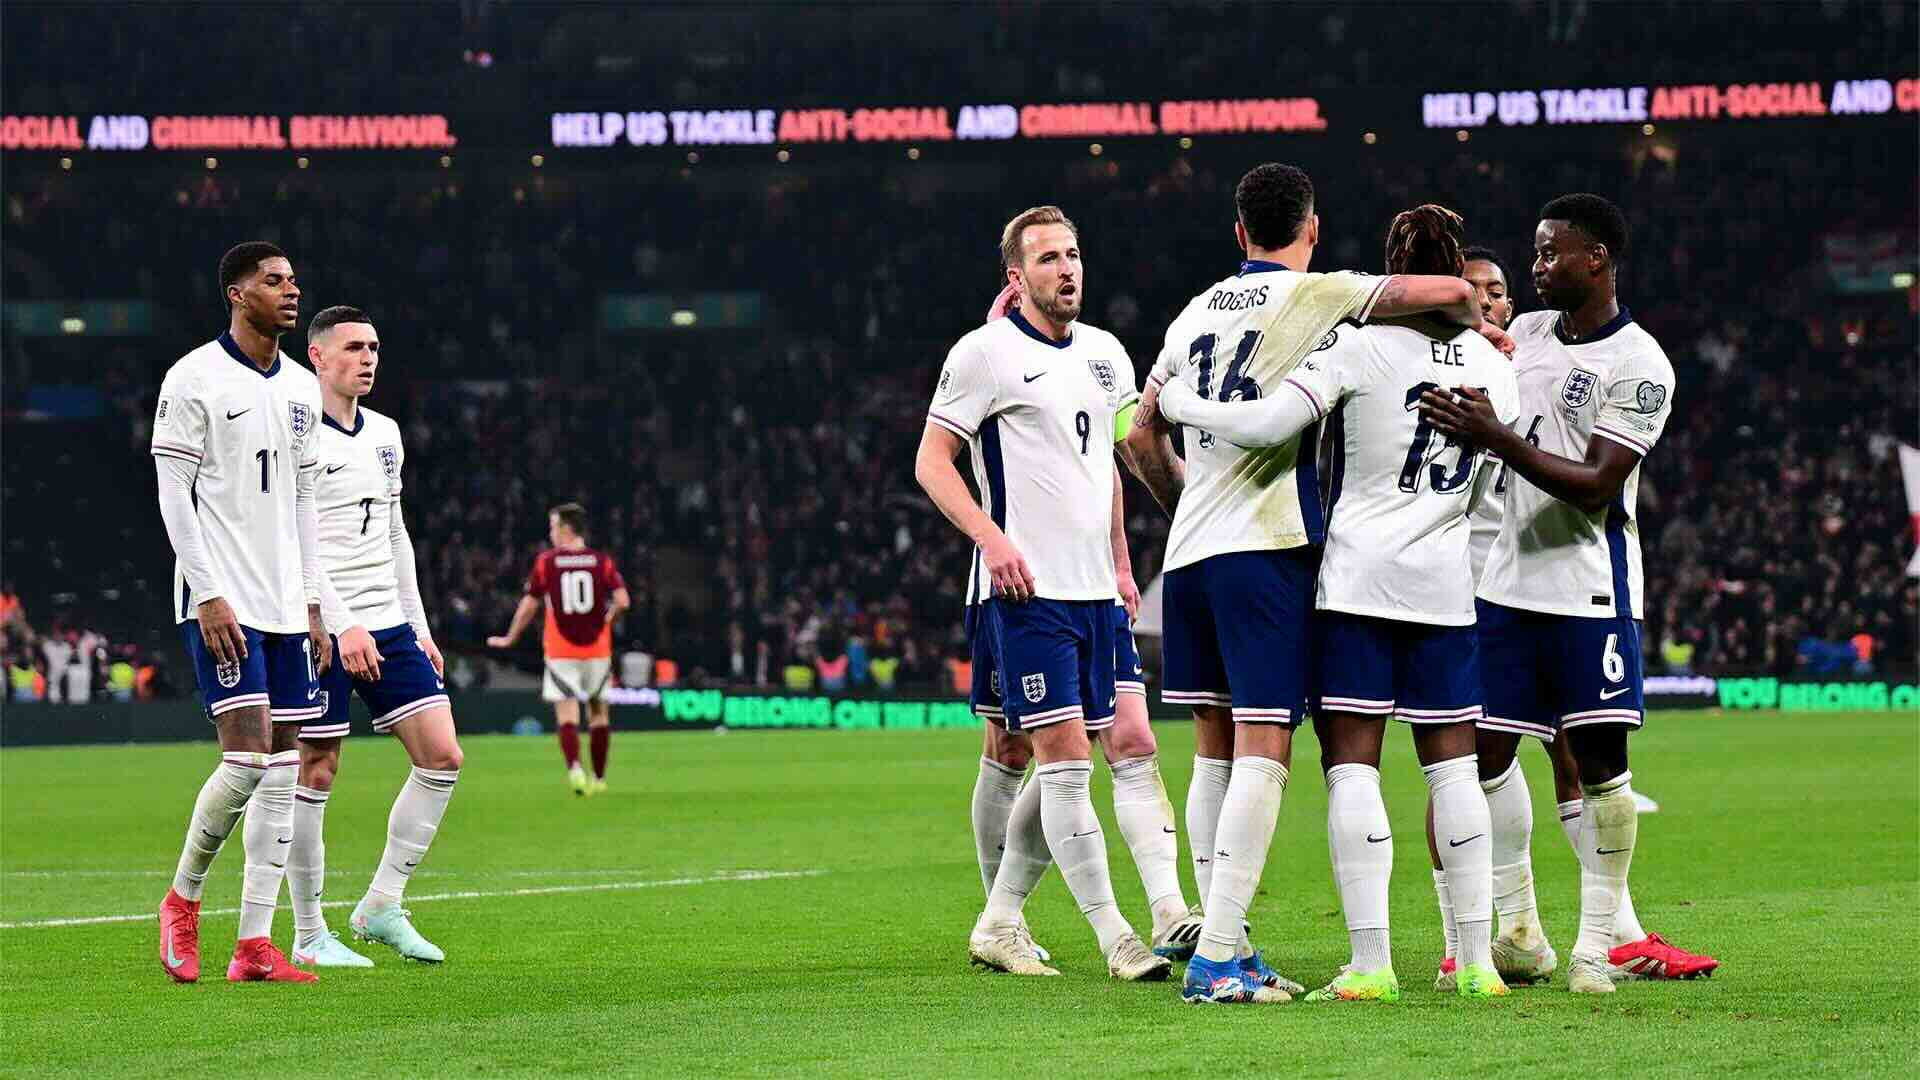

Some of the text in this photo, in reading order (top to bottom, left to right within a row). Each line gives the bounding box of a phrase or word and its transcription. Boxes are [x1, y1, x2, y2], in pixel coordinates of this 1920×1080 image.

[552, 98, 1328, 146] HELP US TACKLE ANTI-SOCIAL AND CRIMINAL BEHAVIOUR.
[1422, 92, 1497, 127] HELP
[1499, 90, 1539, 125] US
[1540, 87, 1648, 123] TACKLE
[1651, 82, 1827, 119] ANTI-SOCIAL
[1830, 79, 1892, 114] AND
[0, 114, 457, 149] OCIAL AND CRIMINAL BEHAVIOUR.
[1207, 285, 1270, 311] ROGERS
[1430, 340, 1465, 366] EZE
[1075, 410, 1091, 456] 9
[359, 498, 374, 536] 7
[560, 570, 594, 615] 10
[1602, 633, 1625, 683] 6
[661, 688, 723, 721] YOU
[724, 696, 832, 728] BELONG
[834, 700, 881, 729] ON
[884, 701, 927, 729] THE
[1717, 677, 1777, 709] YOU
[1779, 682, 1888, 712] BELONG
